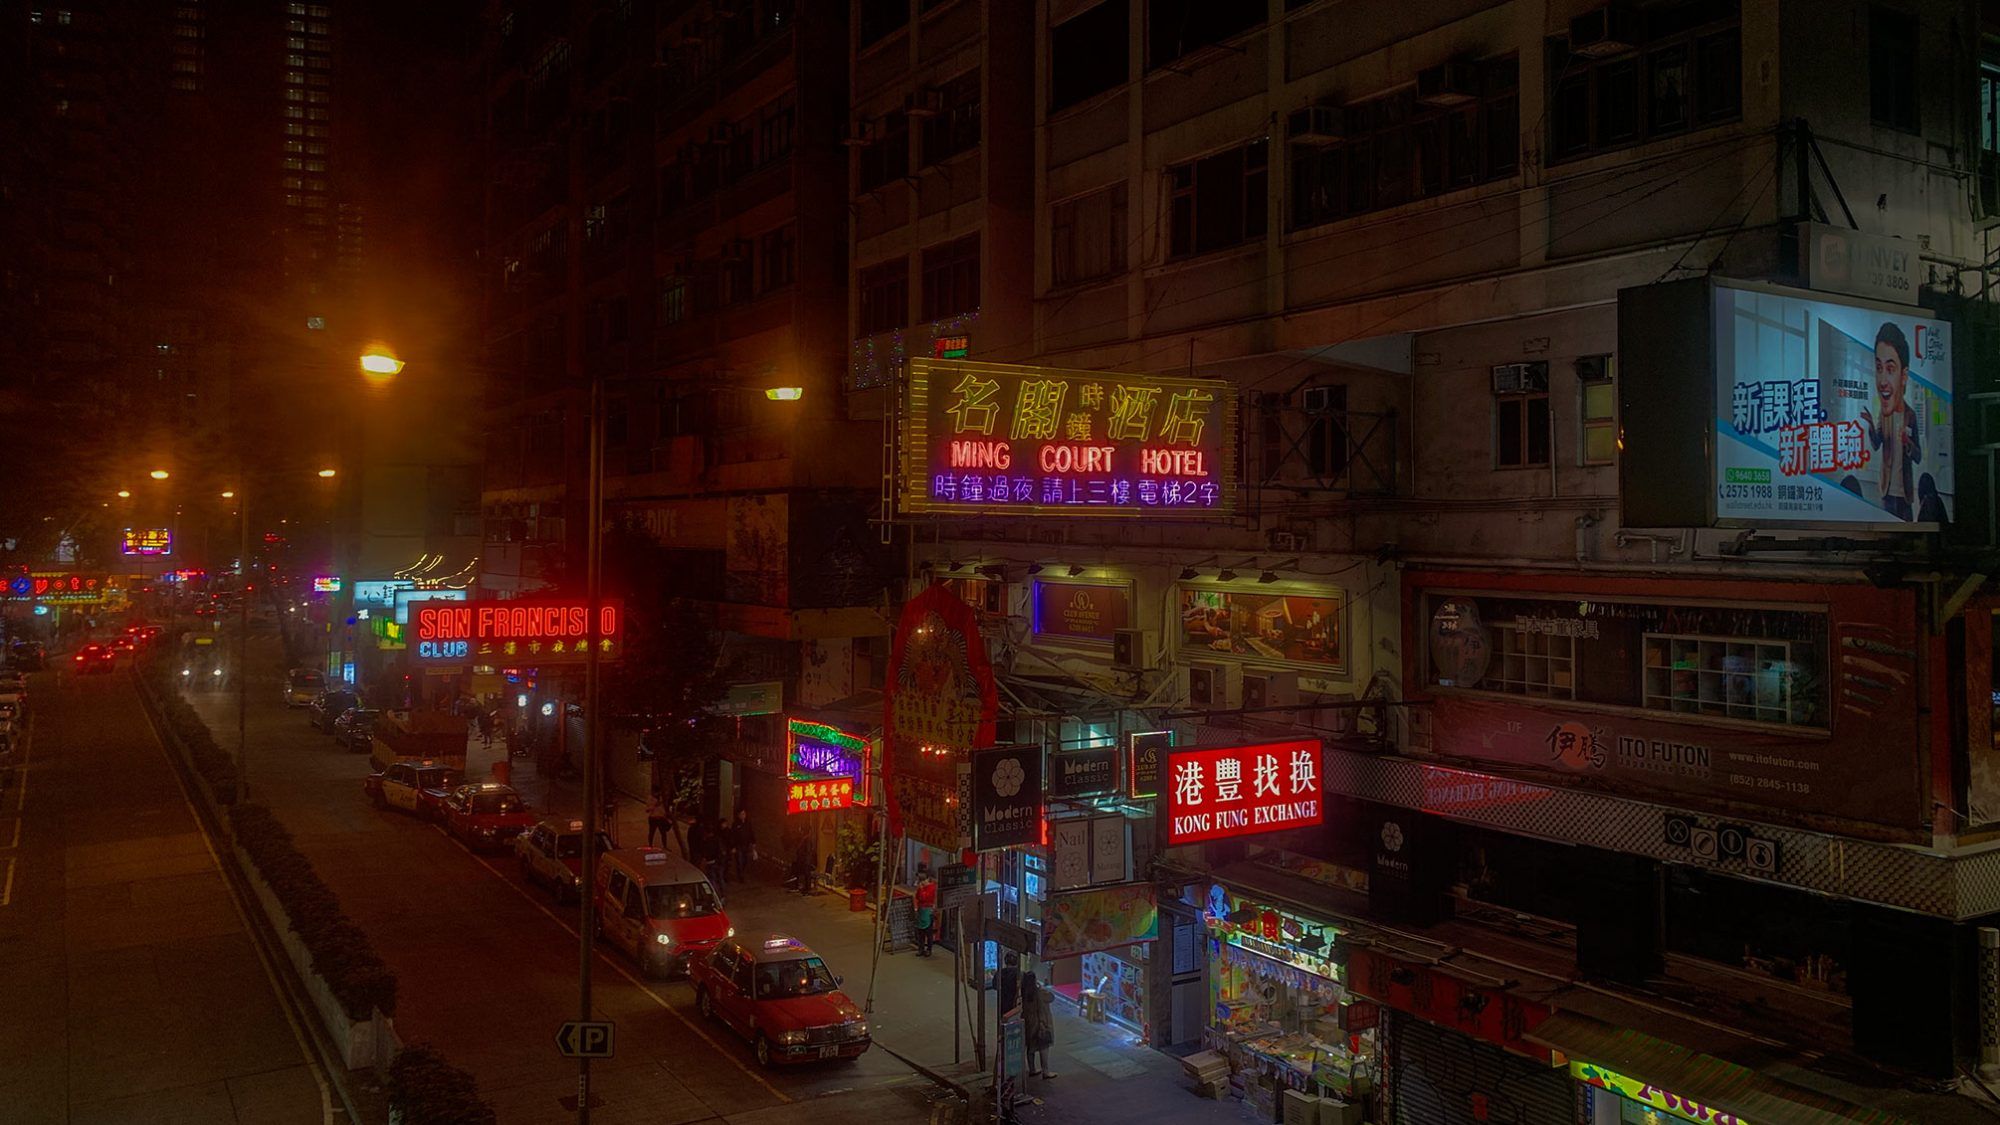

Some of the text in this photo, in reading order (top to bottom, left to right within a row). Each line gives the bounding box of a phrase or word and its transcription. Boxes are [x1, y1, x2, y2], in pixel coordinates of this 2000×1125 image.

[946, 373, 1068, 440] 名閣
[1107, 384, 1214, 447] 酒店
[949, 440, 1209, 476] MING COURT HOTEL
[933, 473, 1034, 503] 時鐘過夜
[1042, 476, 1131, 505] 請上三樓
[1726, 485, 1773, 498] 2575 1988
[419, 606, 616, 640] SAN FRANCISO
[419, 640, 469, 660] CLUB
[1617, 736, 1711, 767] ITO FUTON
[1728, 750, 1820, 771] www.itofuton.com
[1064, 759, 1109, 776] Modern
[1064, 773, 1109, 786] Classic
[1729, 774, 1754, 787] (852)
[983, 804, 1033, 823] Modern
[1174, 799, 1318, 836] KONG FUNG EXCHANGE
[983, 818, 1033, 835] Classic
[1059, 829, 1086, 848] Nail
